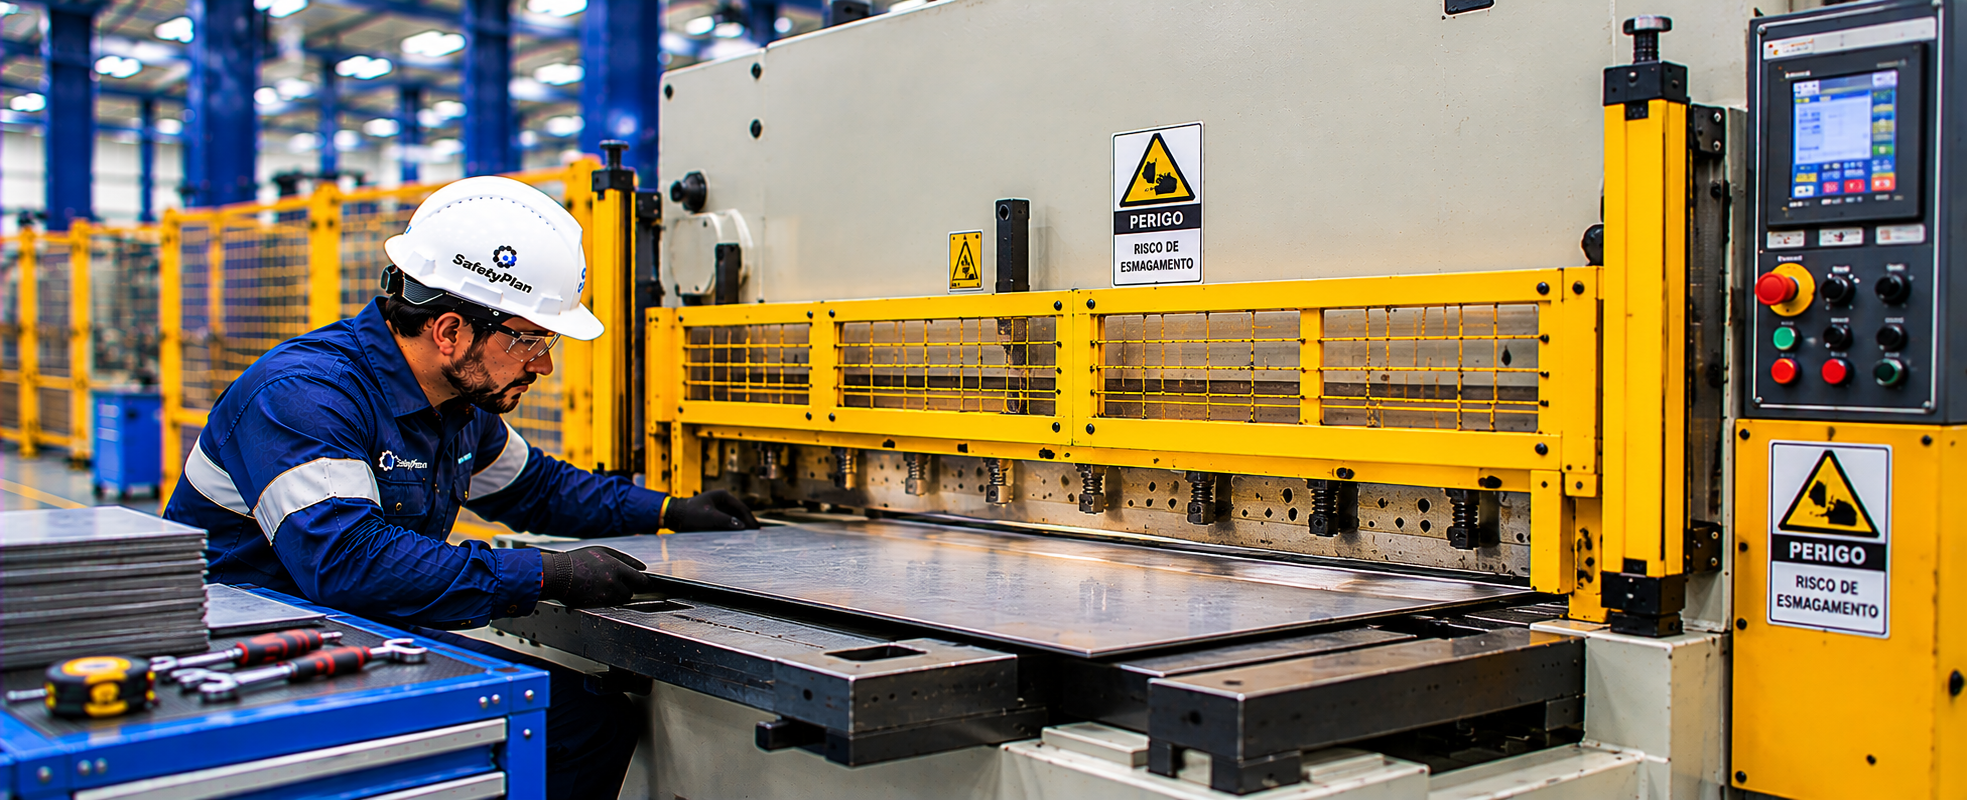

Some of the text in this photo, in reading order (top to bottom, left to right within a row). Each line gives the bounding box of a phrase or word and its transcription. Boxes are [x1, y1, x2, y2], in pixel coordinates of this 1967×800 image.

[1130, 211, 1184, 230] PERIGO
[1134, 240, 1179, 255] RISCO DE
[452, 253, 533, 294] SafetyPlan
[1120, 257, 1194, 273] ESMAGAMENTO
[1789, 541, 1866, 565] PERIGO
[1795, 575, 1859, 595] RISCO DE
[1776, 593, 1879, 619] ESMAGAMENTO
